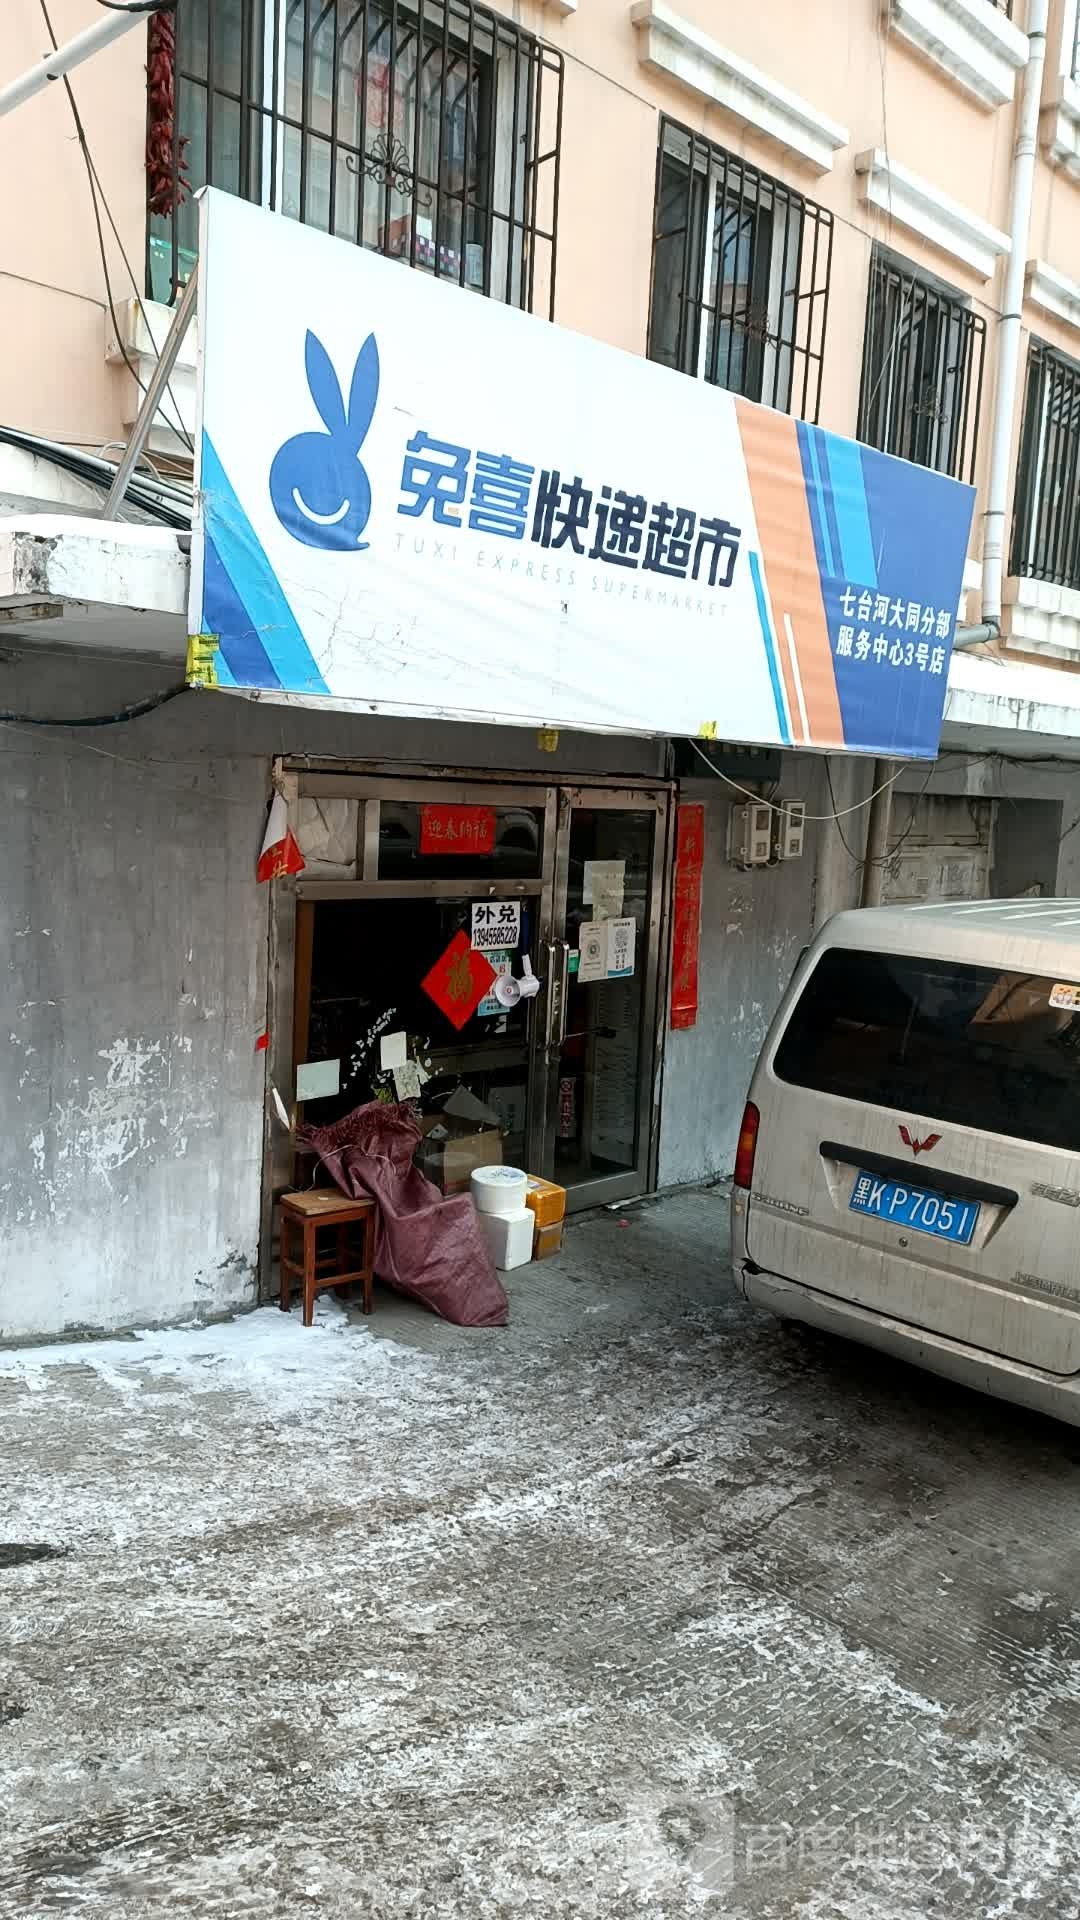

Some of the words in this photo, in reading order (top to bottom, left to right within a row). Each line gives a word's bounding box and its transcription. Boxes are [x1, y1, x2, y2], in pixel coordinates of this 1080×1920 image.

[394, 532, 457, 561] TUXI
[477, 550, 577, 586] EXPRESS
[591, 575, 729, 617] SUPERMARKET
[840, 586, 951, 639] 七台河大同分部
[836, 625, 946, 674] 服务中心3号店
[474, 904, 517, 925] 外兑
